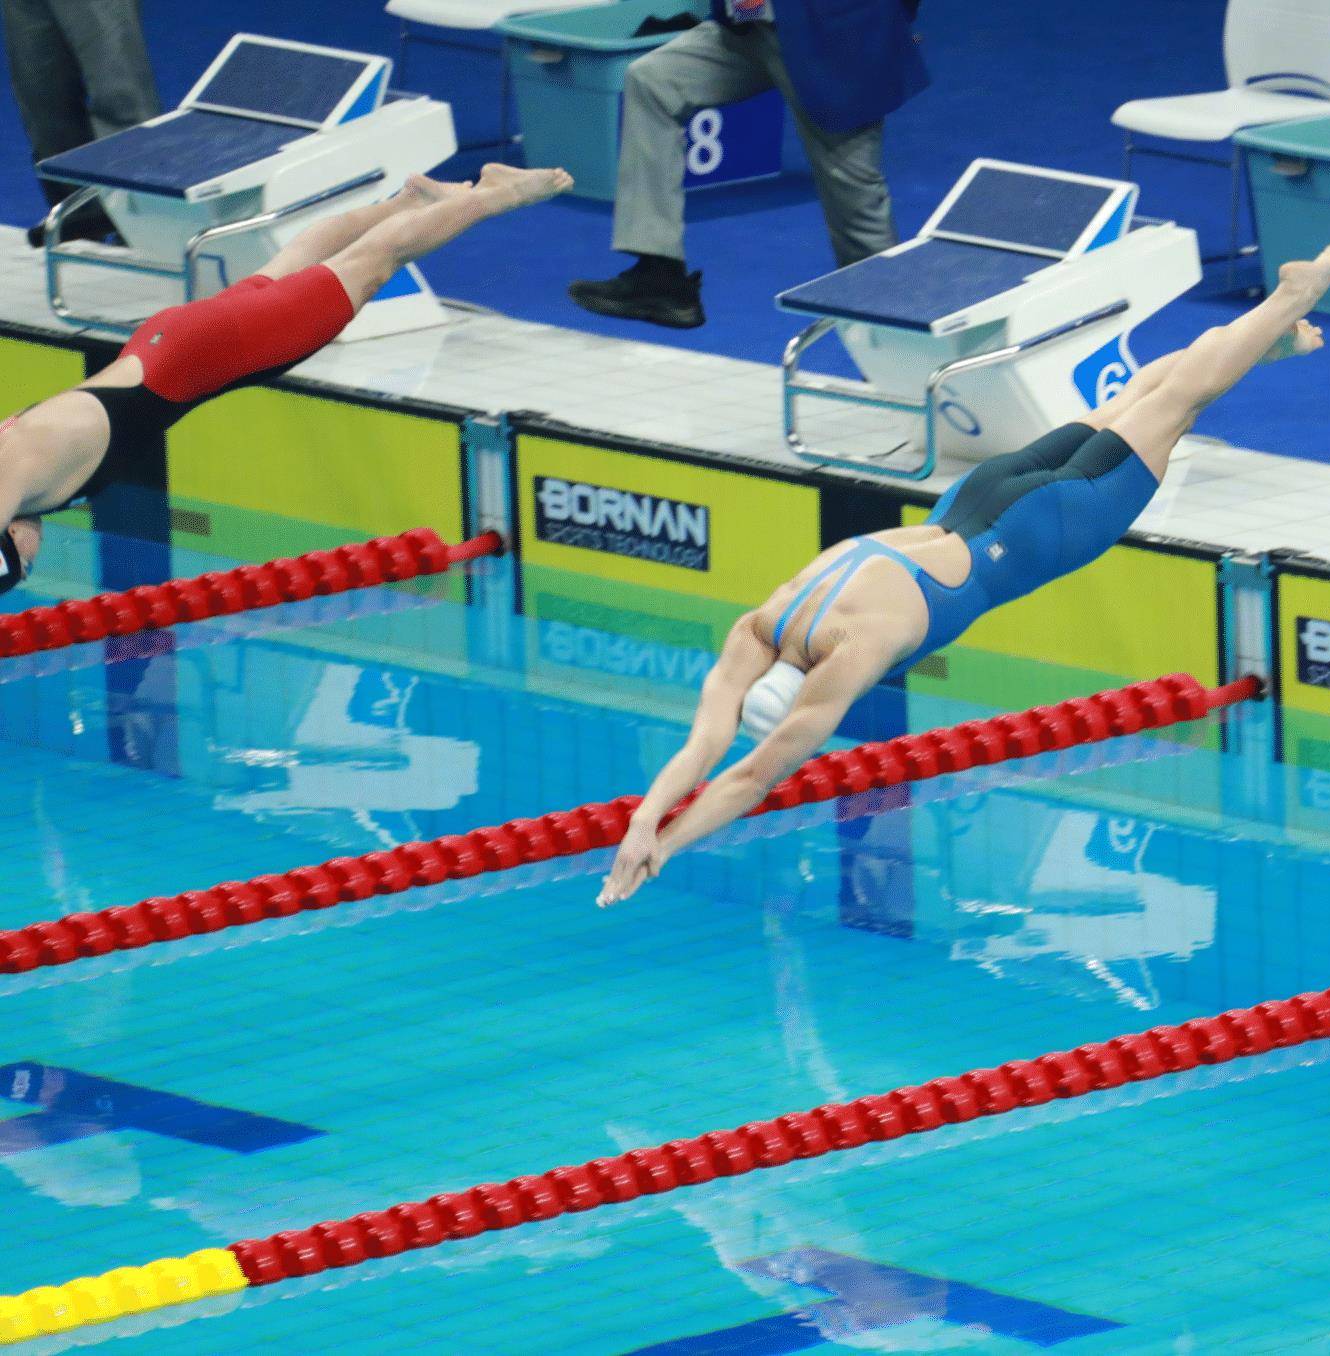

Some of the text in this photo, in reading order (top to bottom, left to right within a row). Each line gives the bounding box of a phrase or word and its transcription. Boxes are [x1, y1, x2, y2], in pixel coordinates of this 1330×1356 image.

[686, 108, 723, 175] 8
[1096, 361, 1127, 410] 6
[538, 478, 707, 547] BORNAN
